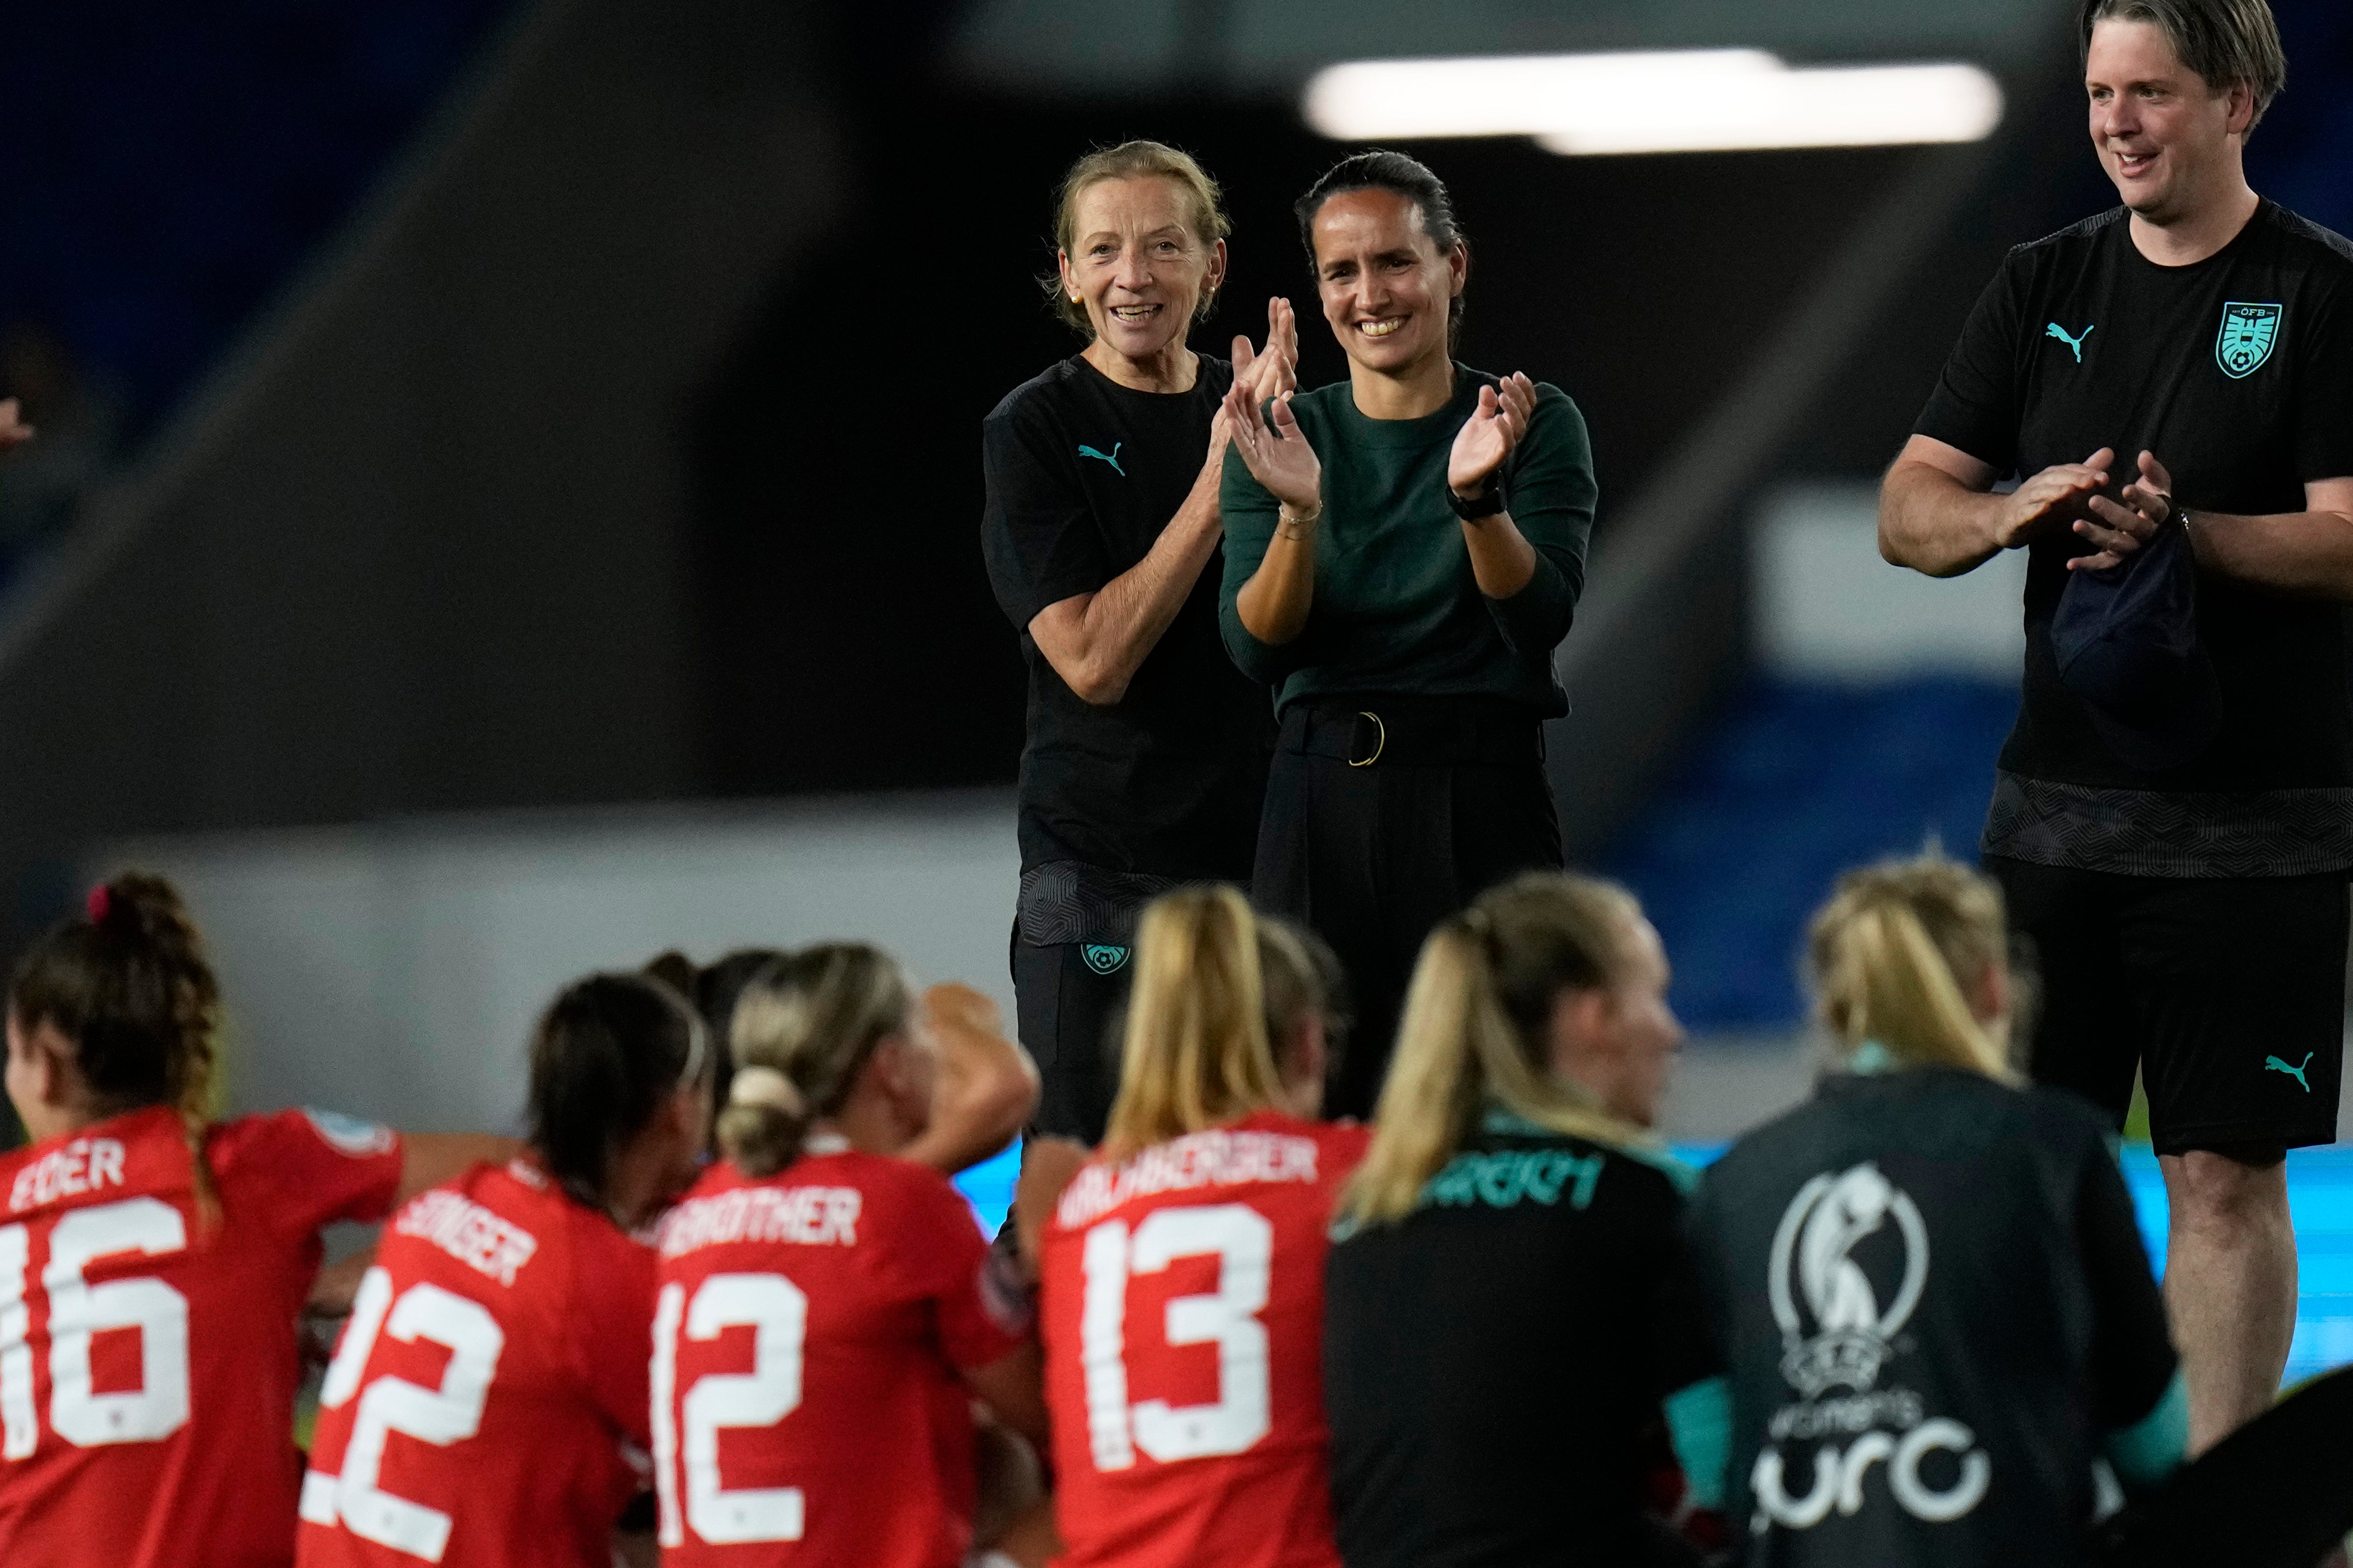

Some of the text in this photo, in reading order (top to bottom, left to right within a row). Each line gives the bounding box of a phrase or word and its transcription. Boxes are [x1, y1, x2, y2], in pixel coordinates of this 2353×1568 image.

[2241, 307, 2265, 316] ÖFB
[8, 1138, 125, 1212] EDER
[0, 1195, 191, 1461] 16
[650, 1272, 808, 1548] 12
[1081, 1203, 1274, 1472] 13
